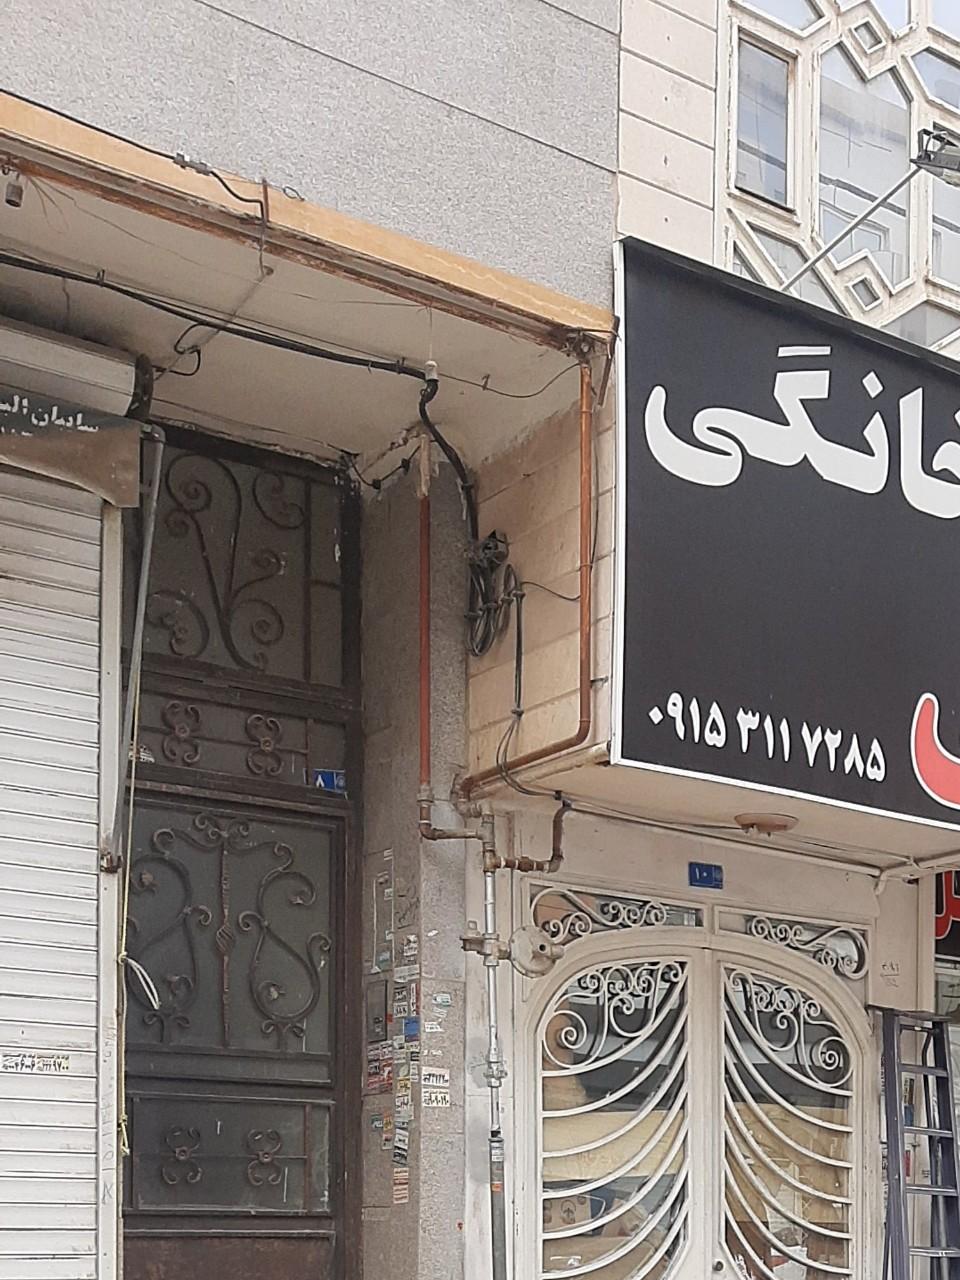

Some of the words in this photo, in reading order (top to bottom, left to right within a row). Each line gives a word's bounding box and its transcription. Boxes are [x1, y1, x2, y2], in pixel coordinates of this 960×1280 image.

[647, 691, 727, 749] ۰۹۱۵
[735, 706, 791, 763] ۳۱۱
[800, 721, 887, 783] ۷۲۸۵
[695, 866, 708, 881] ۱۰
